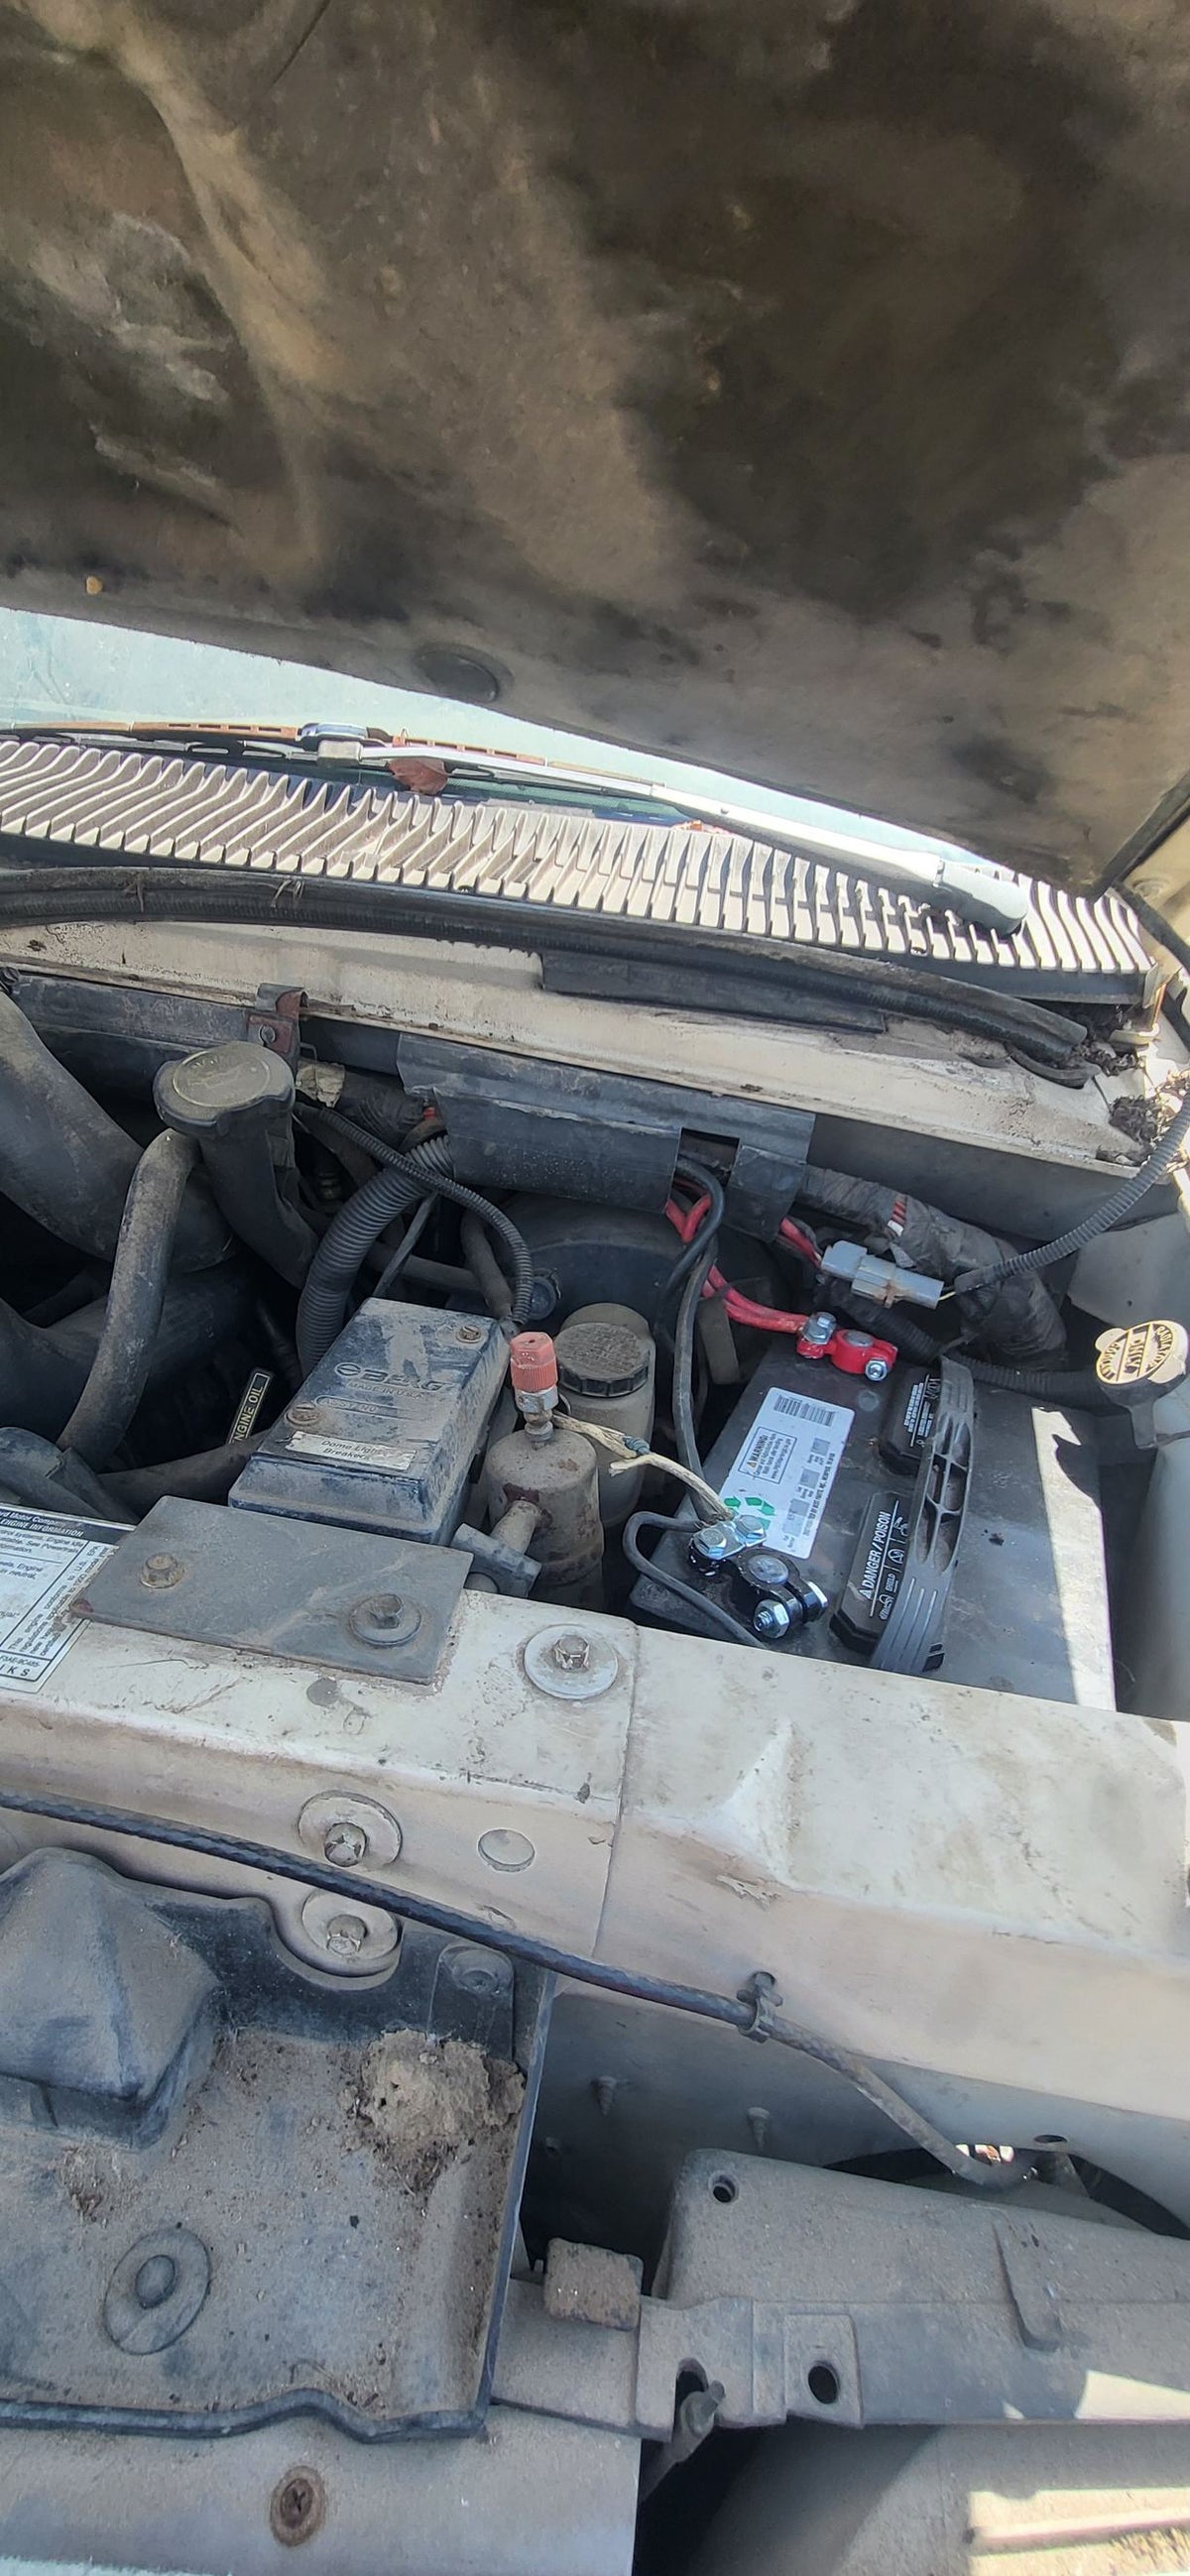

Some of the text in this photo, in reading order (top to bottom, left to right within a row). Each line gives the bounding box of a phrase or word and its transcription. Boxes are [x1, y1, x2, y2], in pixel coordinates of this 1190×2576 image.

[233, 1387, 264, 1443] NGINE OIL
[321, 1440, 352, 1450] Dome
[861, 1550, 883, 1589] DANGER
[873, 1511, 892, 1544] POISON
